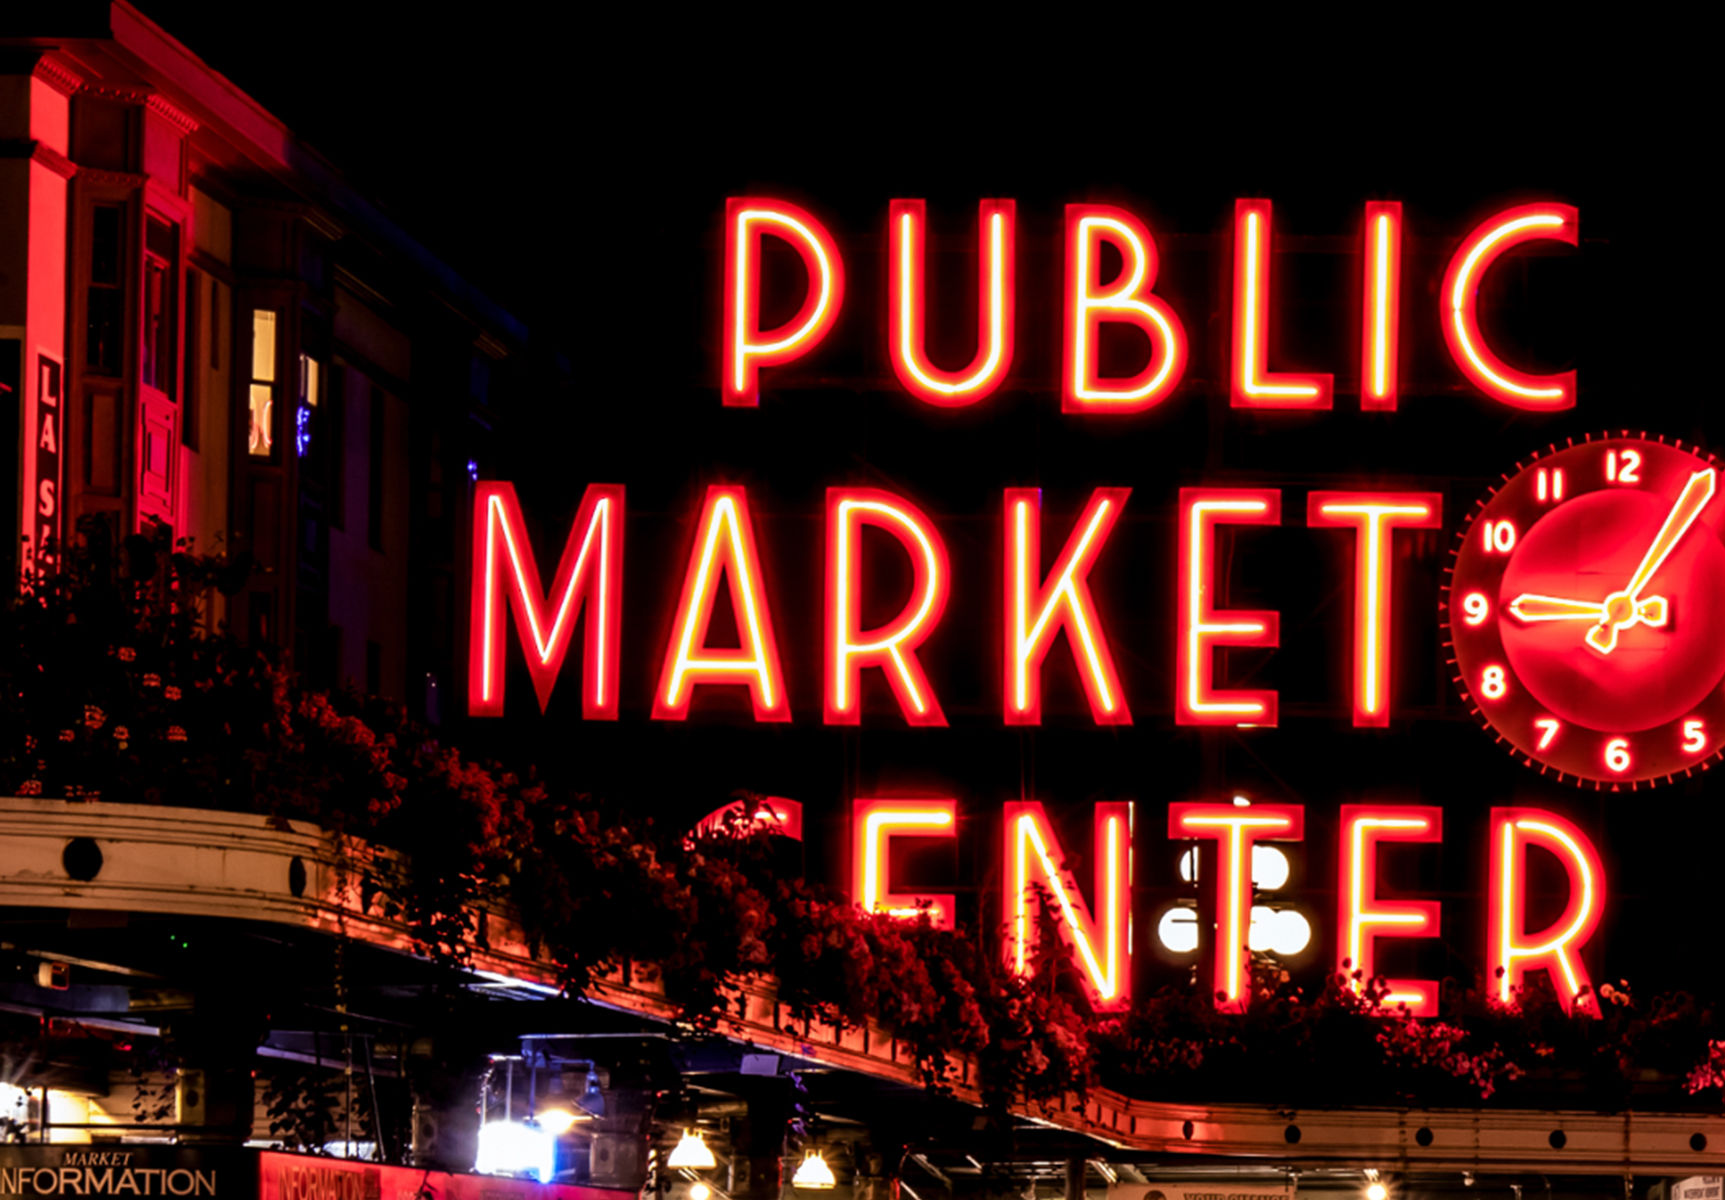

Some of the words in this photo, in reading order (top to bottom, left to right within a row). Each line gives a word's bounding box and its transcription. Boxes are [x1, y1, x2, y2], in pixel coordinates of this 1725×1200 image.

[722, 197, 1578, 413] PUBLIC
[1606, 450, 1640, 482] 12
[1537, 468, 1562, 500] 11
[1483, 521, 1515, 552] 10
[468, 481, 1442, 728] MARKET
[1464, 593, 1488, 625] 9
[1481, 665, 1506, 698] 8
[1535, 720, 1559, 750] 7
[1682, 721, 1705, 752] 5
[1605, 739, 1630, 771] 6
[684, 796, 1605, 1018] ENTER
[63, 1152, 132, 1166] MARKET
[0, 1168, 216, 1196] NFORMATION
